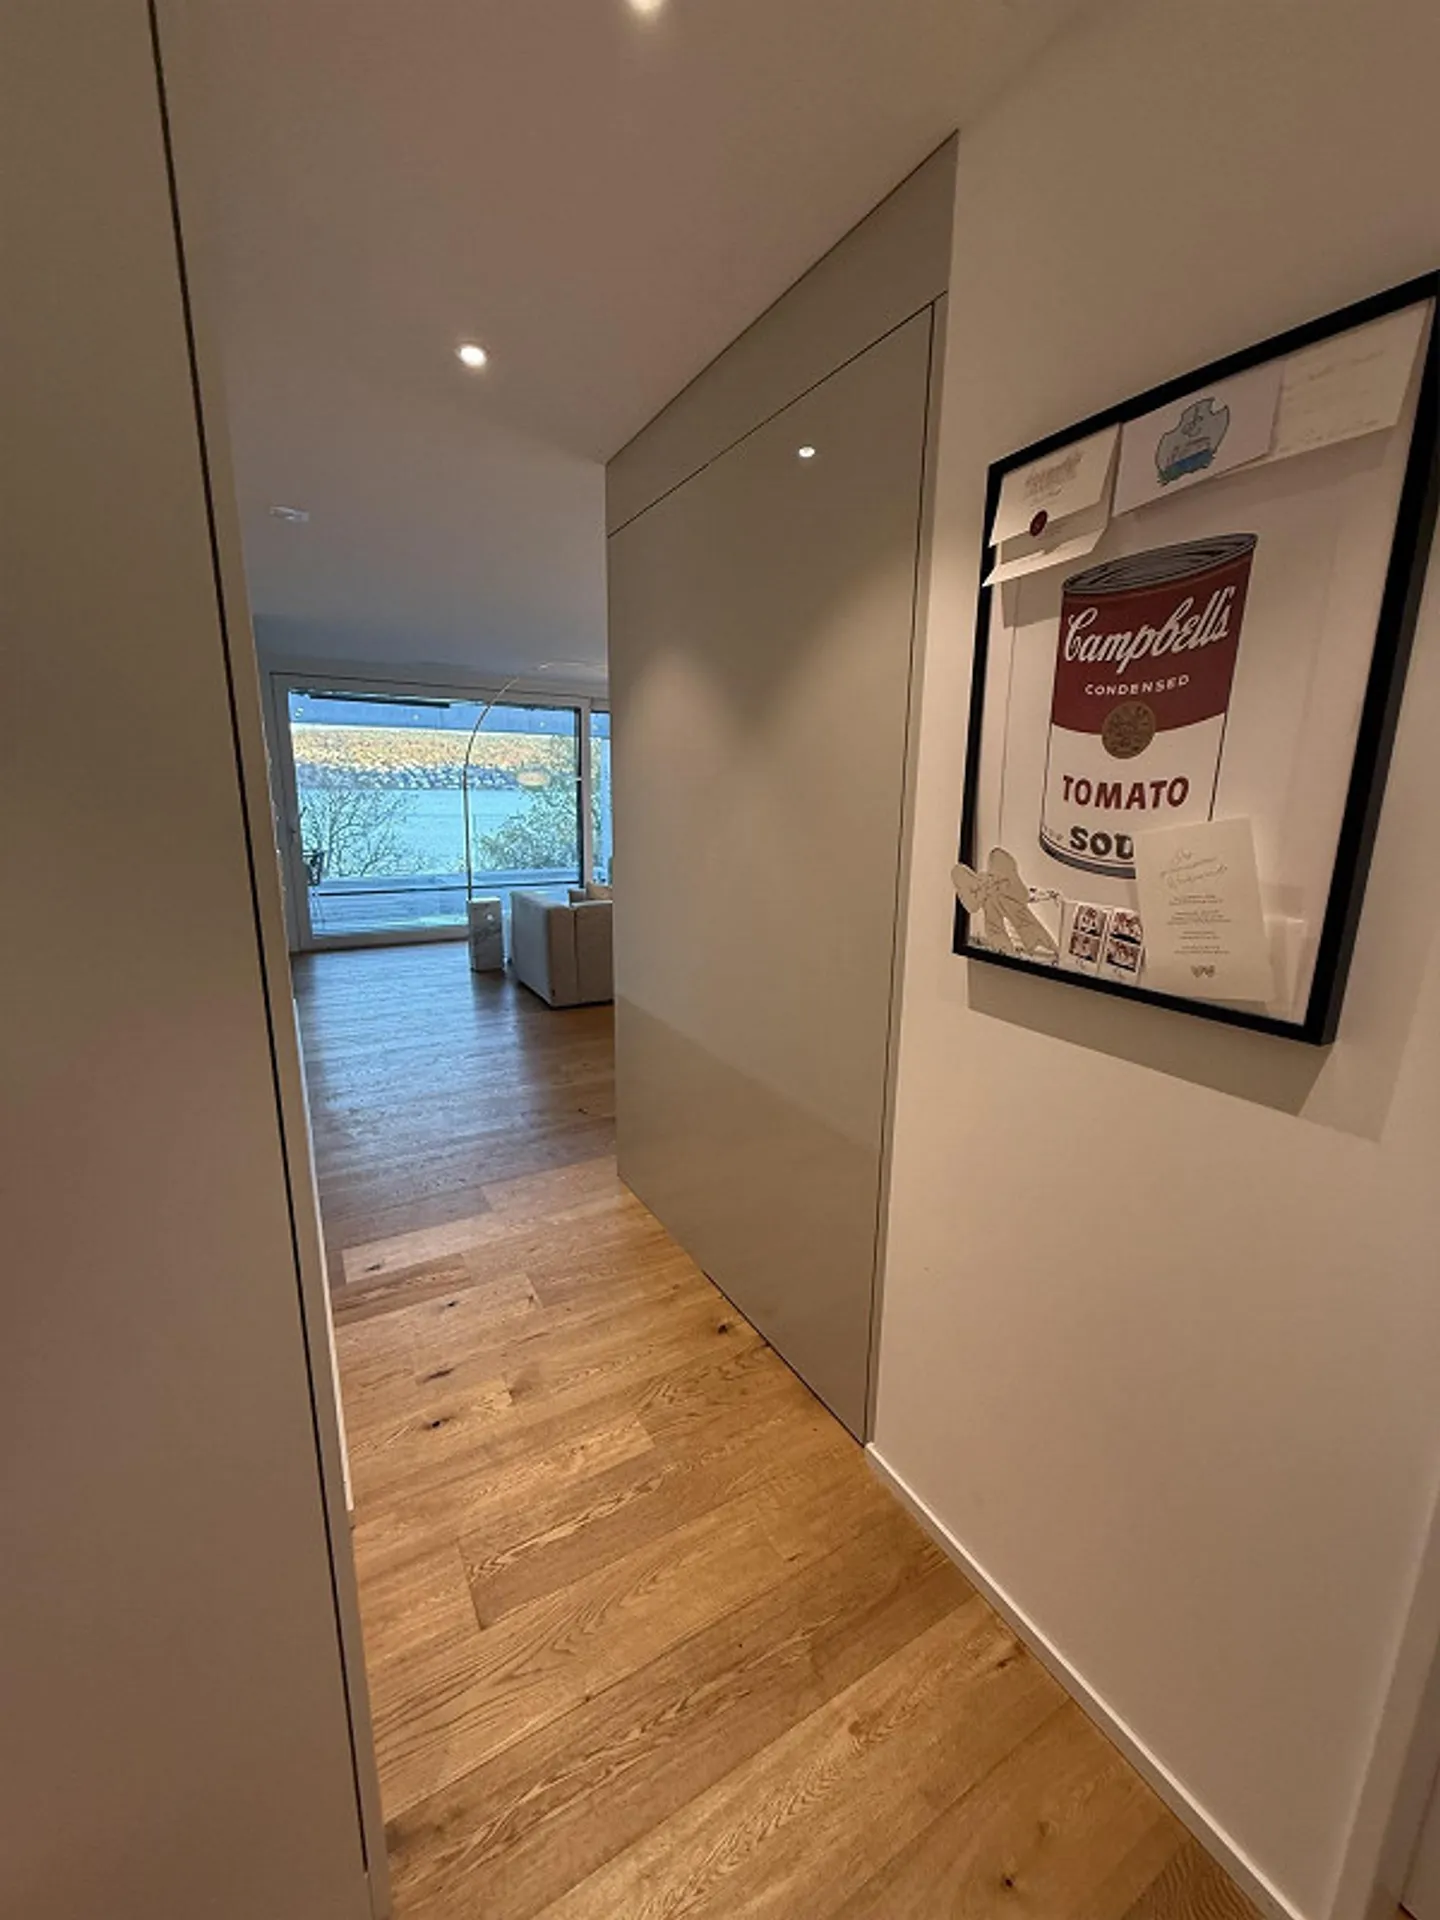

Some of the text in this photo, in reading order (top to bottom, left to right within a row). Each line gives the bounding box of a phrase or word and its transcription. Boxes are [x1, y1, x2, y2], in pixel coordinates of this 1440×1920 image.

[1085, 674, 1190, 695] CONDENSED
[1063, 775, 1189, 810] TOMATO
[1069, 826, 1134, 860] SOU
